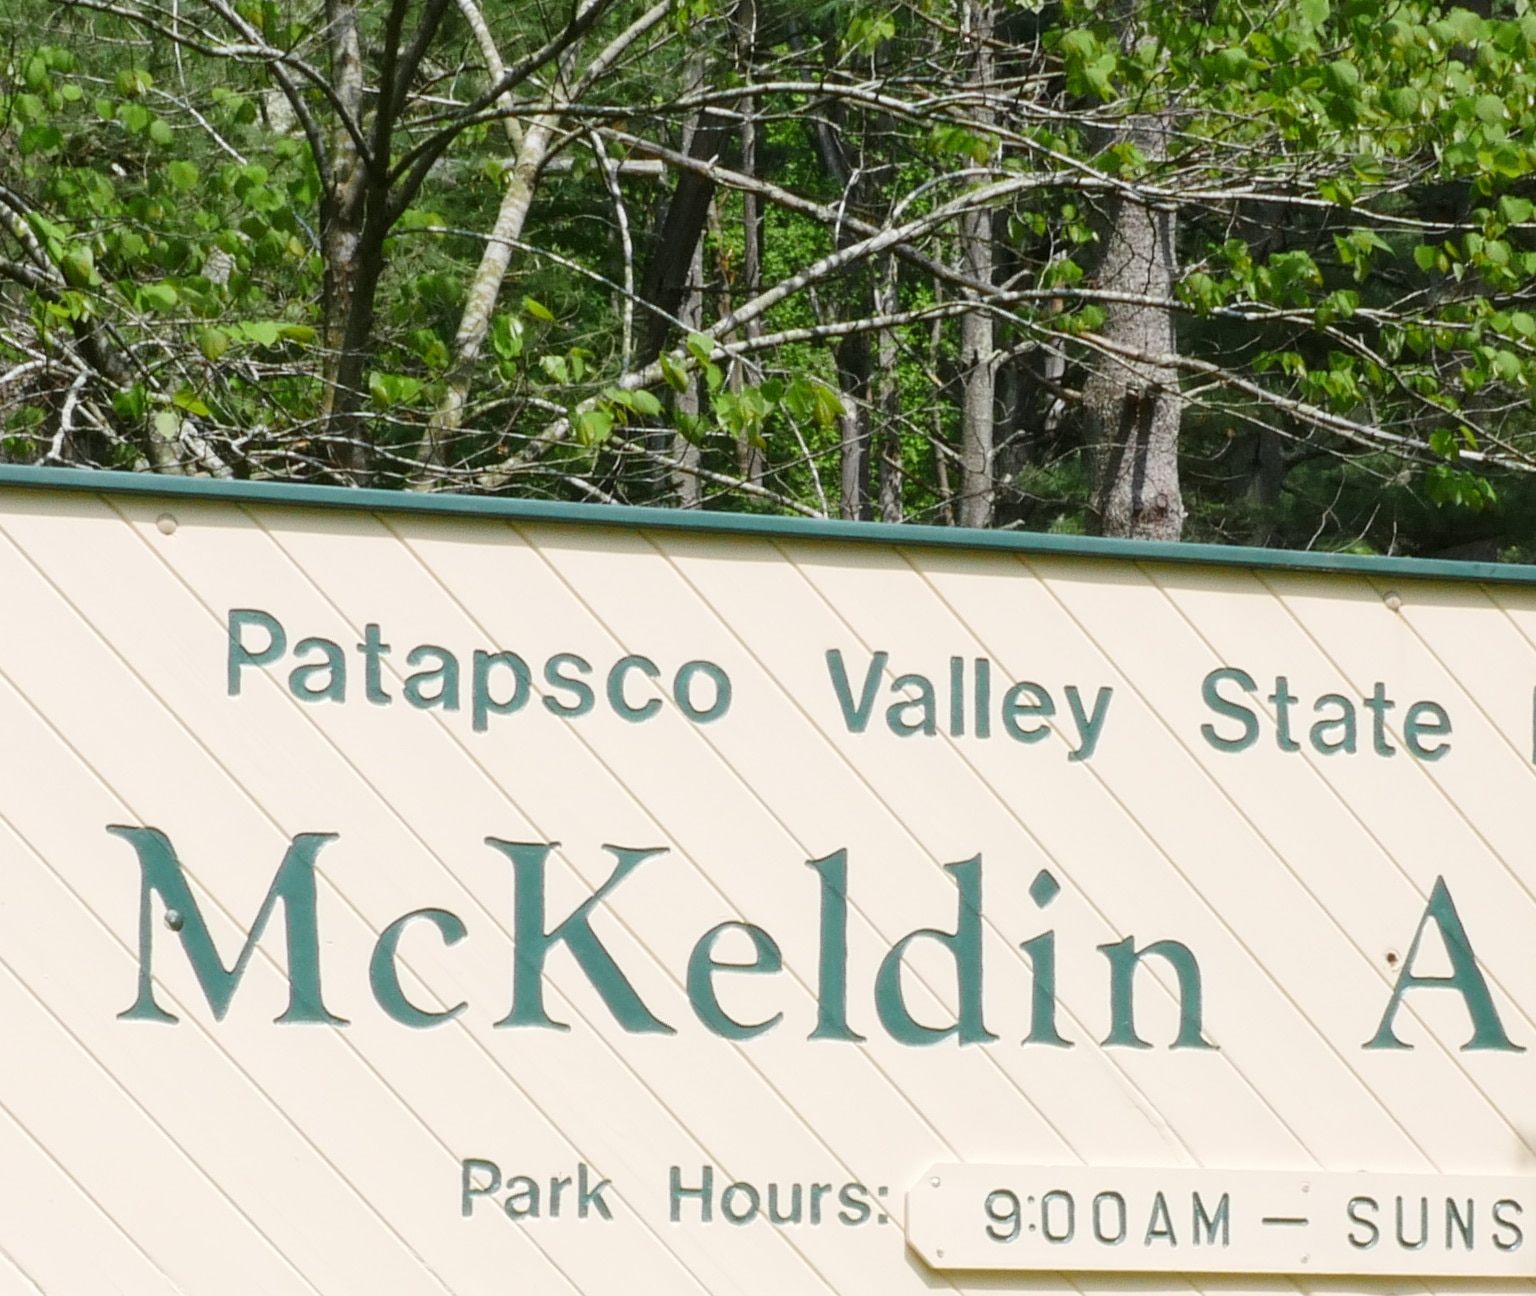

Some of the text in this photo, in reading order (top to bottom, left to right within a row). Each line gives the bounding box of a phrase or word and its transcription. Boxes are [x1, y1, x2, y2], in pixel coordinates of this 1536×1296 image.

[226, 607, 733, 733] Patapsco
[825, 647, 1113, 761] Valley
[1199, 665, 1454, 761] State
[105, 822, 1221, 1050] McKeldin
[461, 1157, 614, 1224] Park
[667, 1164, 890, 1228] Hours:
[982, 1186, 1232, 1250] 9:00AM
